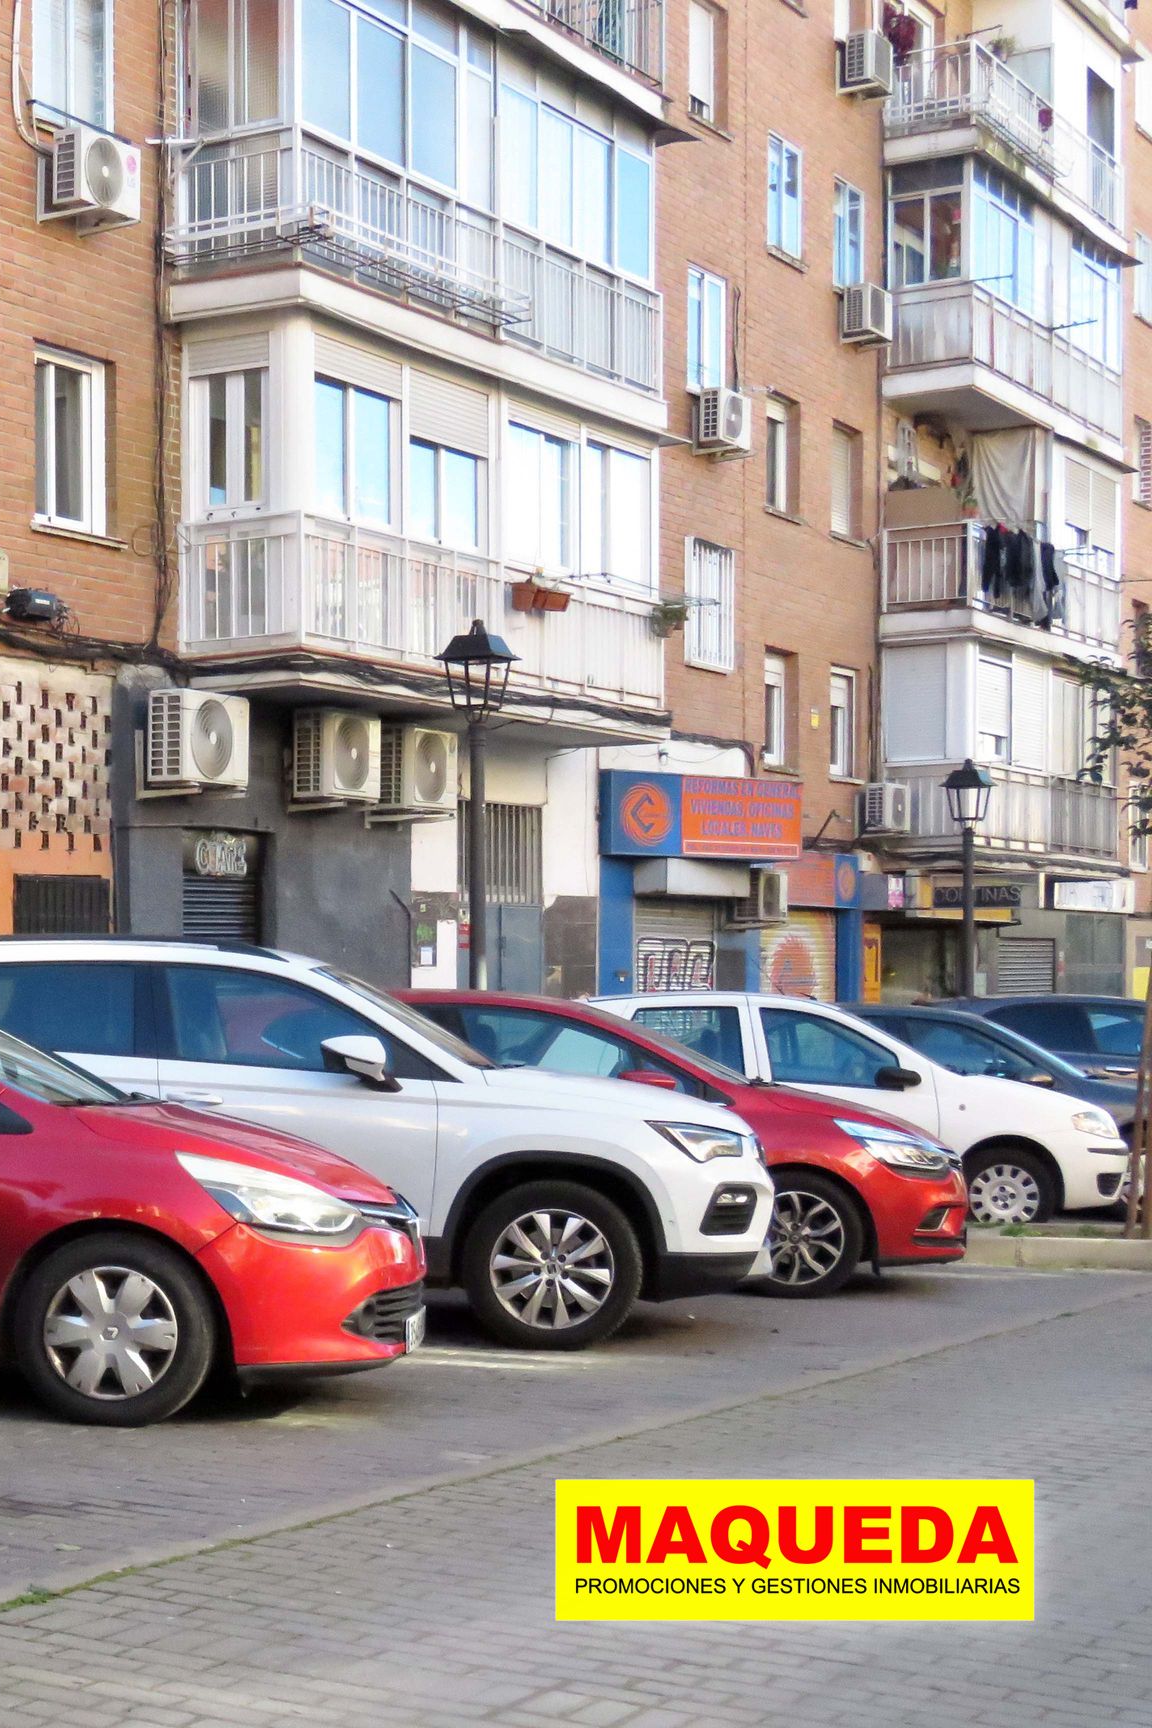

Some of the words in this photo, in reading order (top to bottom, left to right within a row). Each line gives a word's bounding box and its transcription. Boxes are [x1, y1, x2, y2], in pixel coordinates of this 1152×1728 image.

[685, 777, 738, 795] REFORMAS
[741, 781, 754, 797] EN
[934, 885, 1022, 902] COINAS
